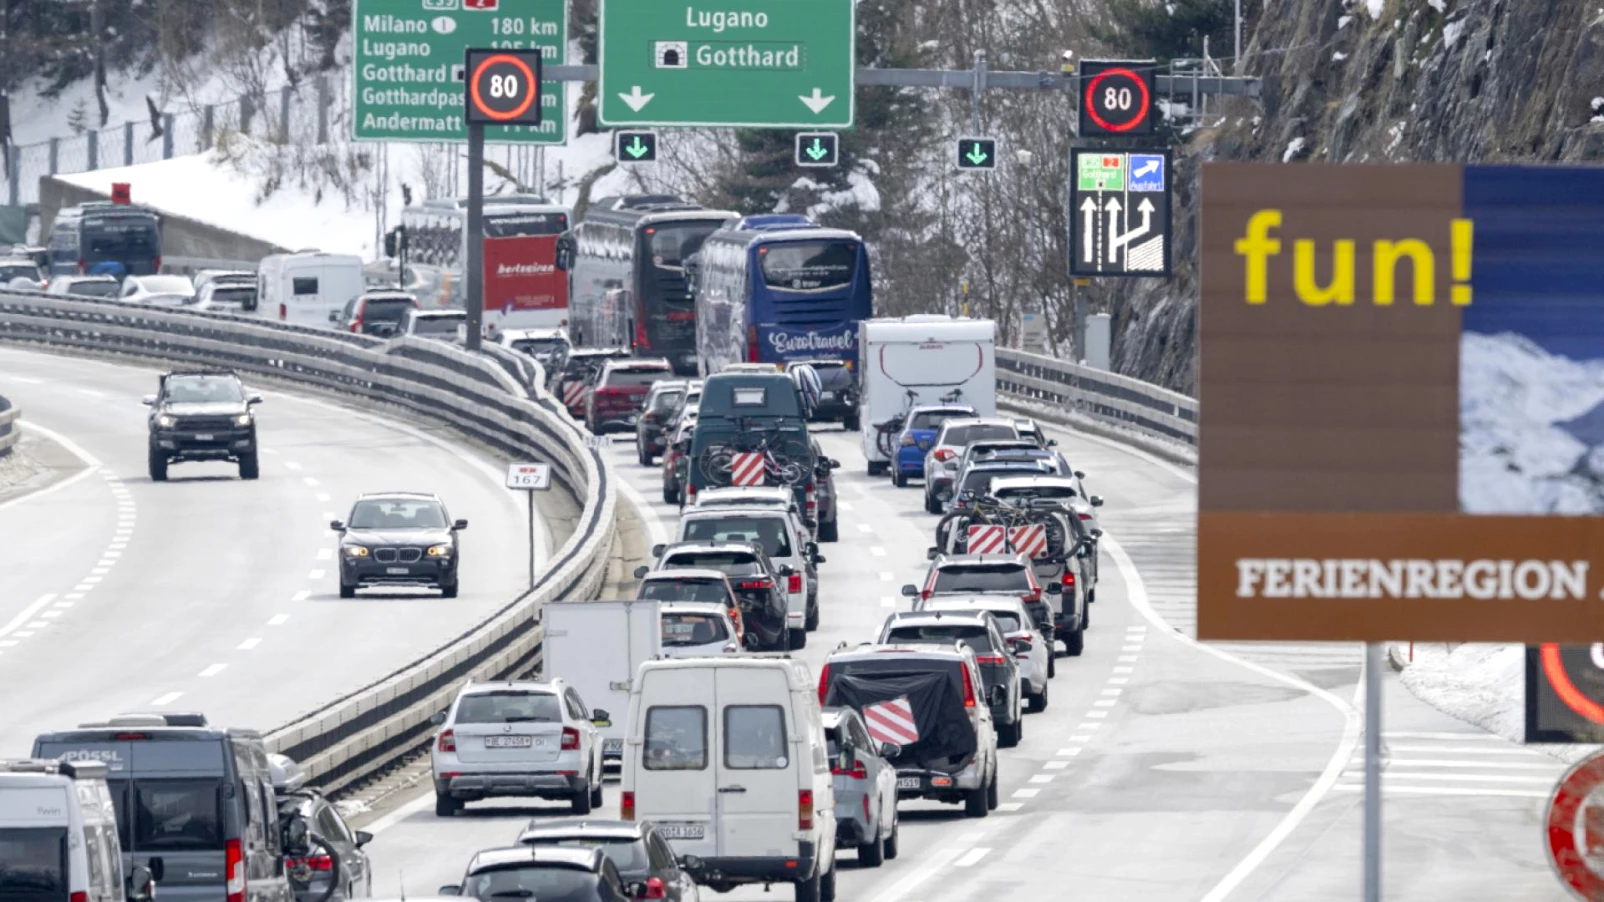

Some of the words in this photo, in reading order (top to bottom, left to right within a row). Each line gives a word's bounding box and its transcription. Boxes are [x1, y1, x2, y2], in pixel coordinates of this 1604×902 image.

[364, 15, 427, 33] Milano
[491, 18, 524, 34] 180
[531, 17, 558, 35] km
[686, 6, 768, 32] Lugano
[363, 39, 430, 60] Lugano
[696, 44, 799, 66] Gotthard
[362, 64, 446, 82] Gotthard
[490, 74, 518, 98] 80
[1104, 87, 1132, 110] 80
[363, 113, 461, 131] Andermatt
[1082, 169, 1117, 179] Gotthard
[1235, 209, 1474, 307] fun!
[768, 329, 854, 354] Eurotravel
[513, 474, 541, 485] 167
[1236, 557, 1589, 599] FERIENREGION
[36, 806, 61, 816] Twin
